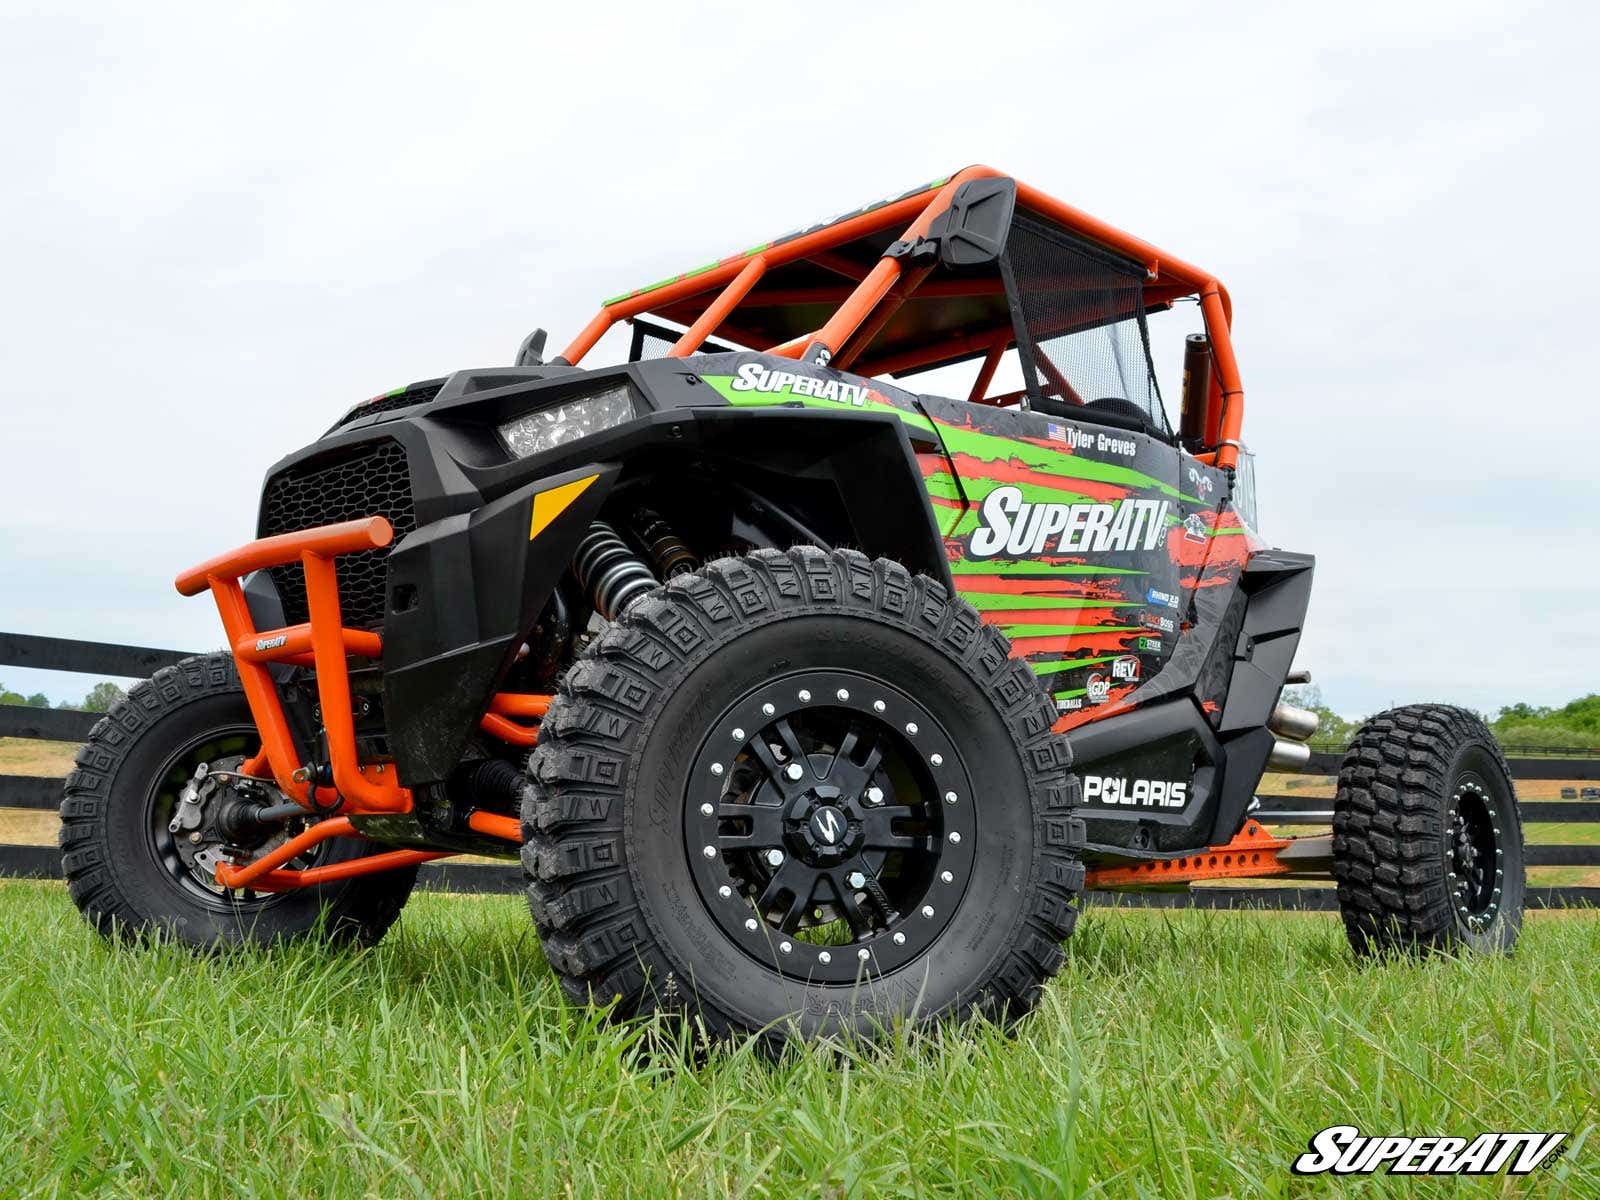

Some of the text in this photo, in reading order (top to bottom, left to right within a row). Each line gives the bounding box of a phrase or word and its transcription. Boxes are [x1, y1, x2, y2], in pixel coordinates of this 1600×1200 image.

[732, 363, 869, 406] SUPERATV
[1067, 427, 1136, 456] Tyler Greves
[970, 486, 1169, 556] SUPERATV
[1112, 660, 1138, 678] REV
[1091, 680, 1111, 696] GDP
[1083, 776, 1187, 807] POLARIS
